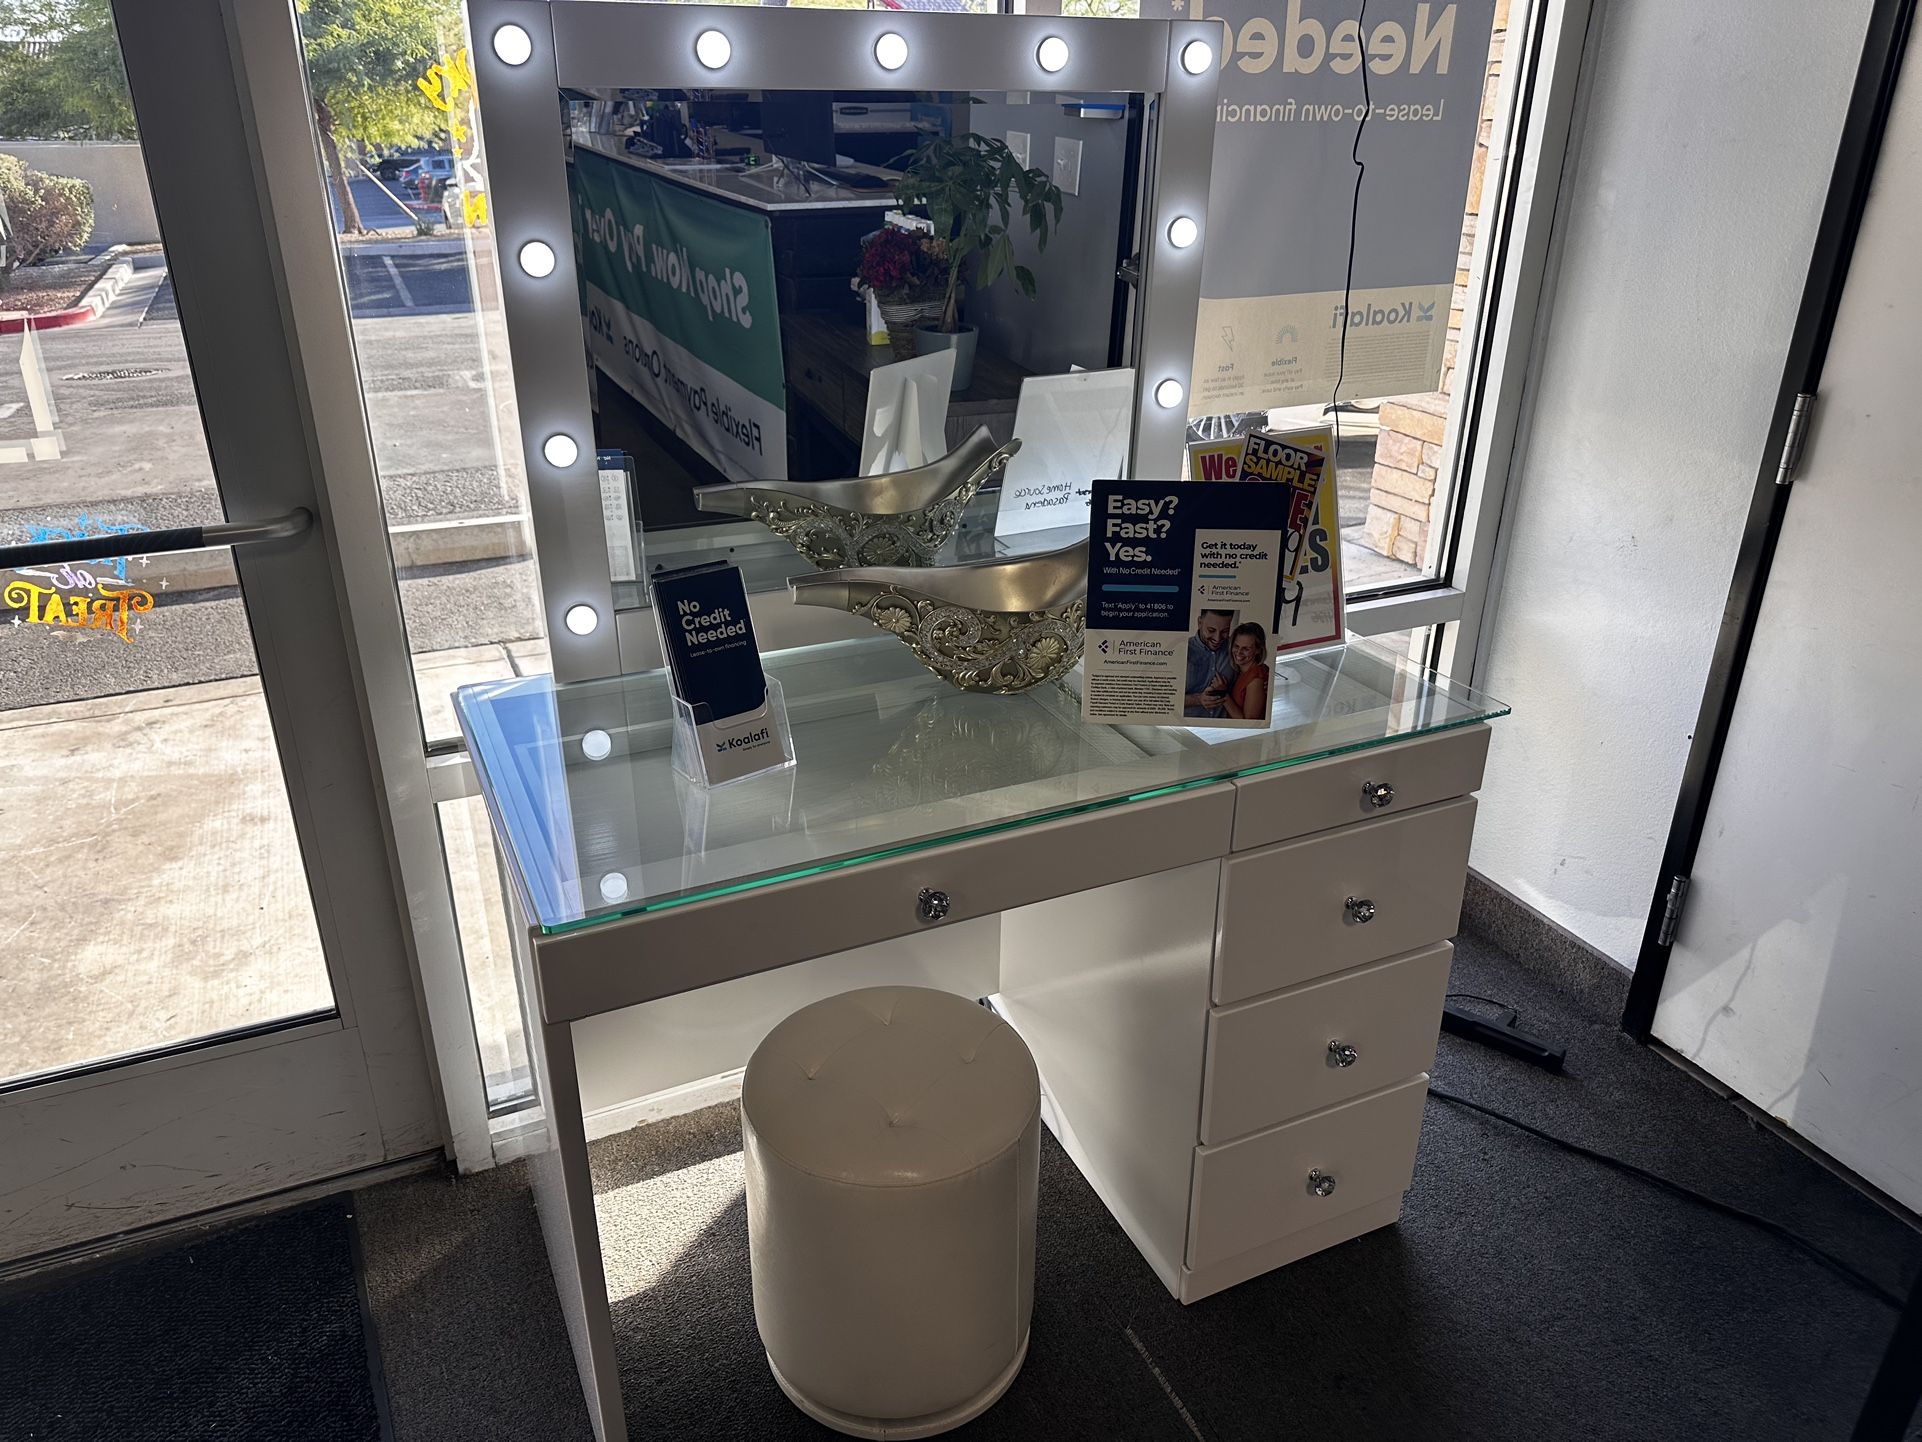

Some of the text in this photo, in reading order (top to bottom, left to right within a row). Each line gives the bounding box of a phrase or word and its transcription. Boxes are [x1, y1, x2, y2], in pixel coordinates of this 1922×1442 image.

[1246, 435, 1309, 472] FLOOR
[1200, 453, 1238, 481] We
[1243, 454, 1319, 491] SAMPLE
[1107, 494, 1179, 518] Easy?
[1106, 518, 1171, 539] Fast?
[1104, 542, 1152, 562] Yes.
[1200, 550, 1269, 560] with no credit
[1201, 541, 1258, 552] Get it today
[1103, 567, 1119, 575] With
[1119, 567, 1129, 575] No
[1130, 567, 1151, 575] Credit
[676, 599, 700, 616] No
[1101, 601, 1114, 609] Text
[1146, 602, 1166, 610] 41806
[1101, 609, 1170, 619] begin your application.
[681, 607, 732, 631] Credit
[724, 639, 747, 650] financing
[1118, 648, 1138, 656] First
[1119, 639, 1162, 648] American
[727, 727, 770, 749] Koalafi
